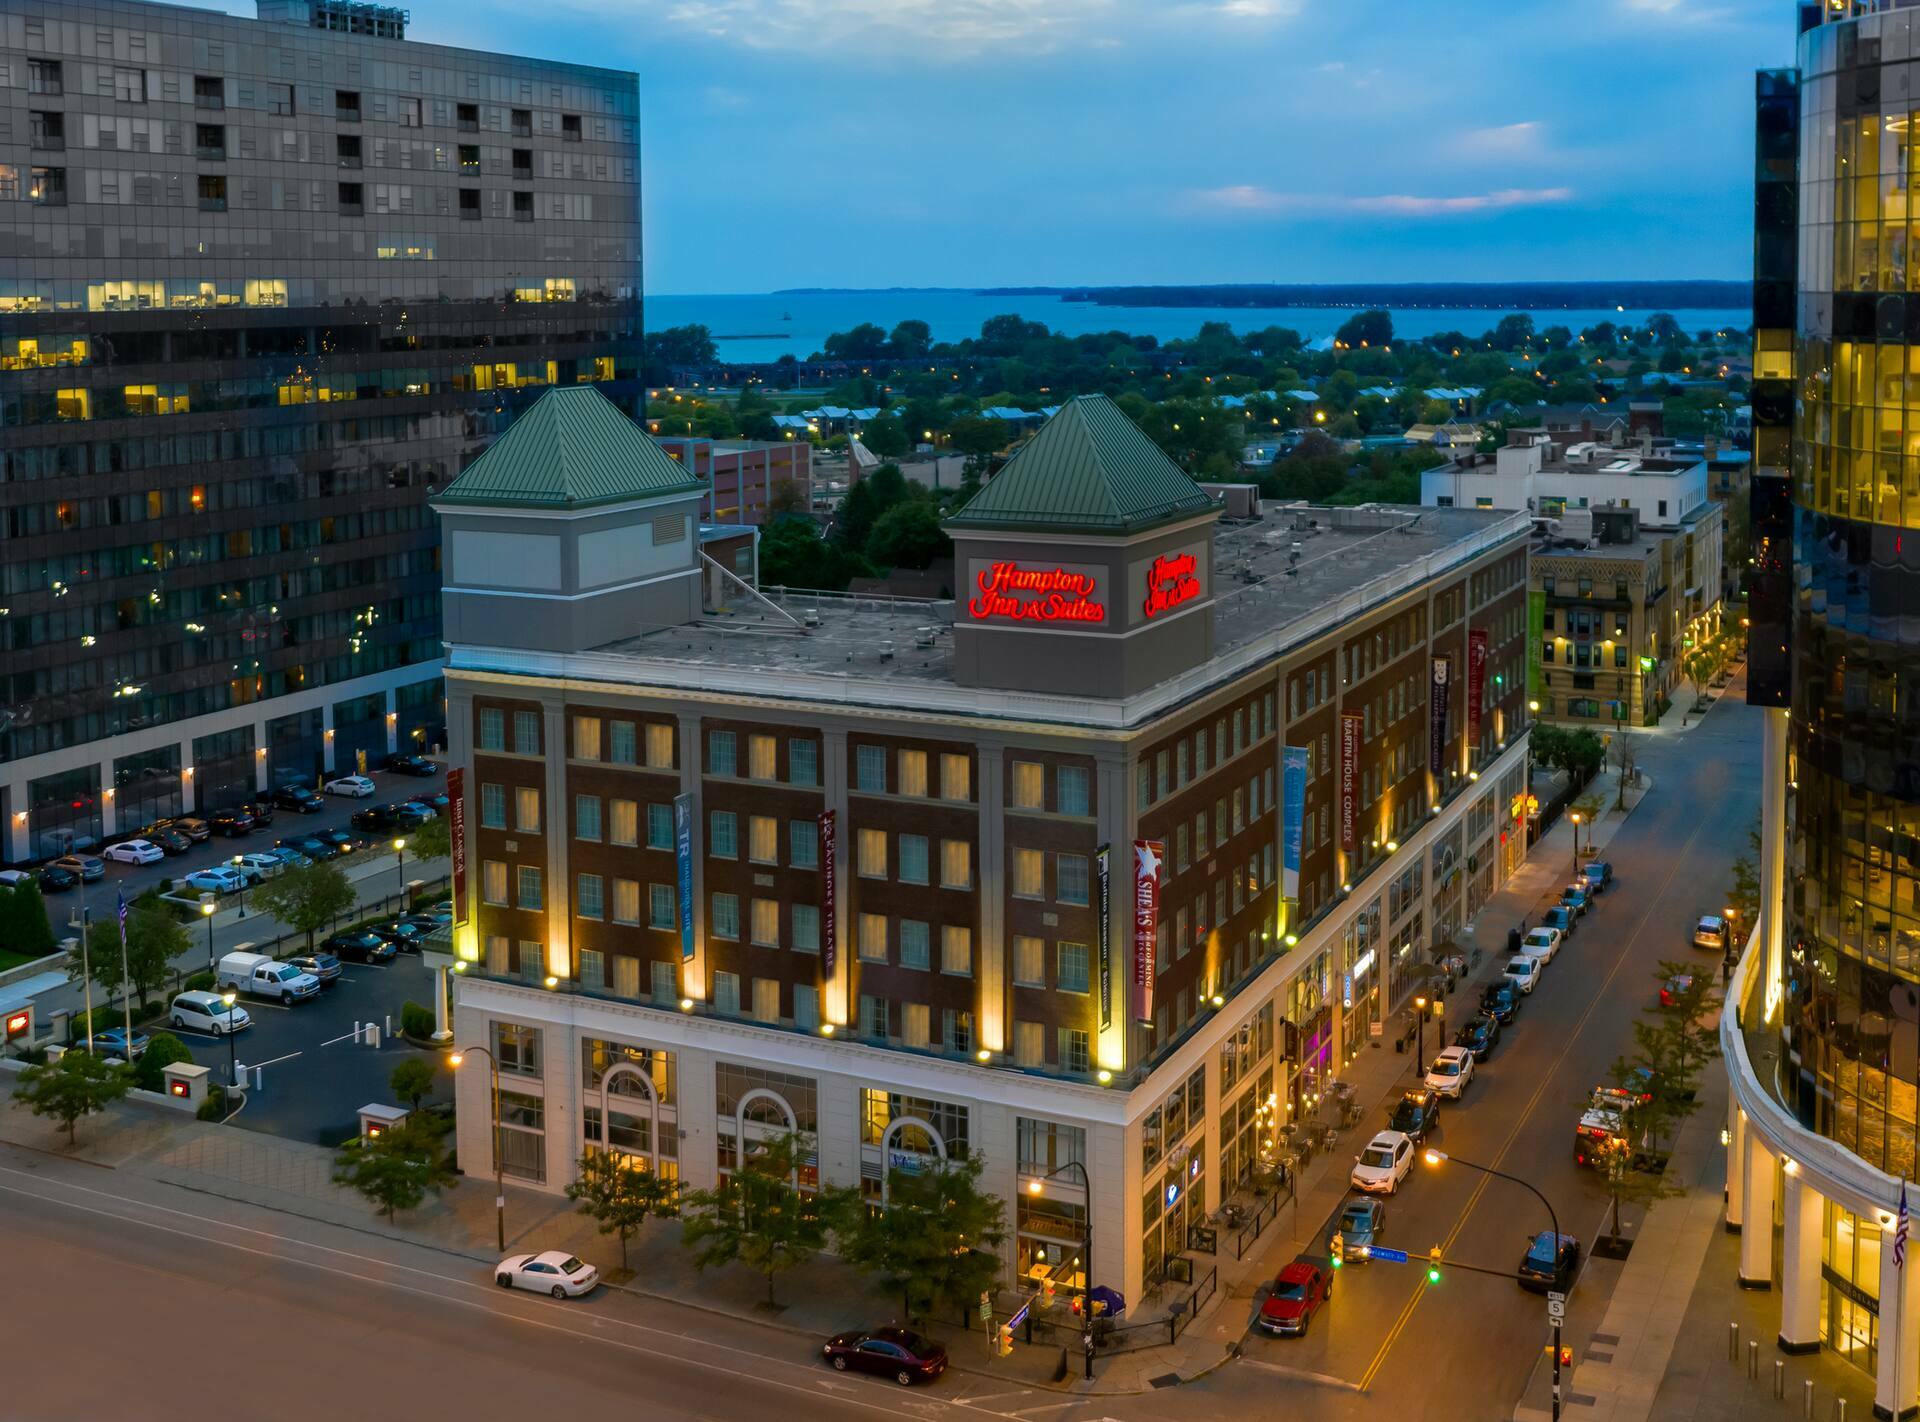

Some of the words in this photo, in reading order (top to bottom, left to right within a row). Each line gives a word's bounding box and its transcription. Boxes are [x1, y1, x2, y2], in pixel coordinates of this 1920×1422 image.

[978, 561, 1096, 596] Hampton
[1148, 553, 1197, 592] Hampton
[968, 591, 1028, 619] Inn
[1028, 600, 1043, 621] &
[1040, 593, 1105, 622] Suites
[1344, 719, 1353, 757] MARTIN
[1344, 760, 1353, 792] HOUSE
[1344, 795, 1352, 842] COMPLEX
[680, 828, 690, 858] TR
[1138, 880, 1153, 926] SHEA'S
[1553, 1303, 1560, 1312] 5
